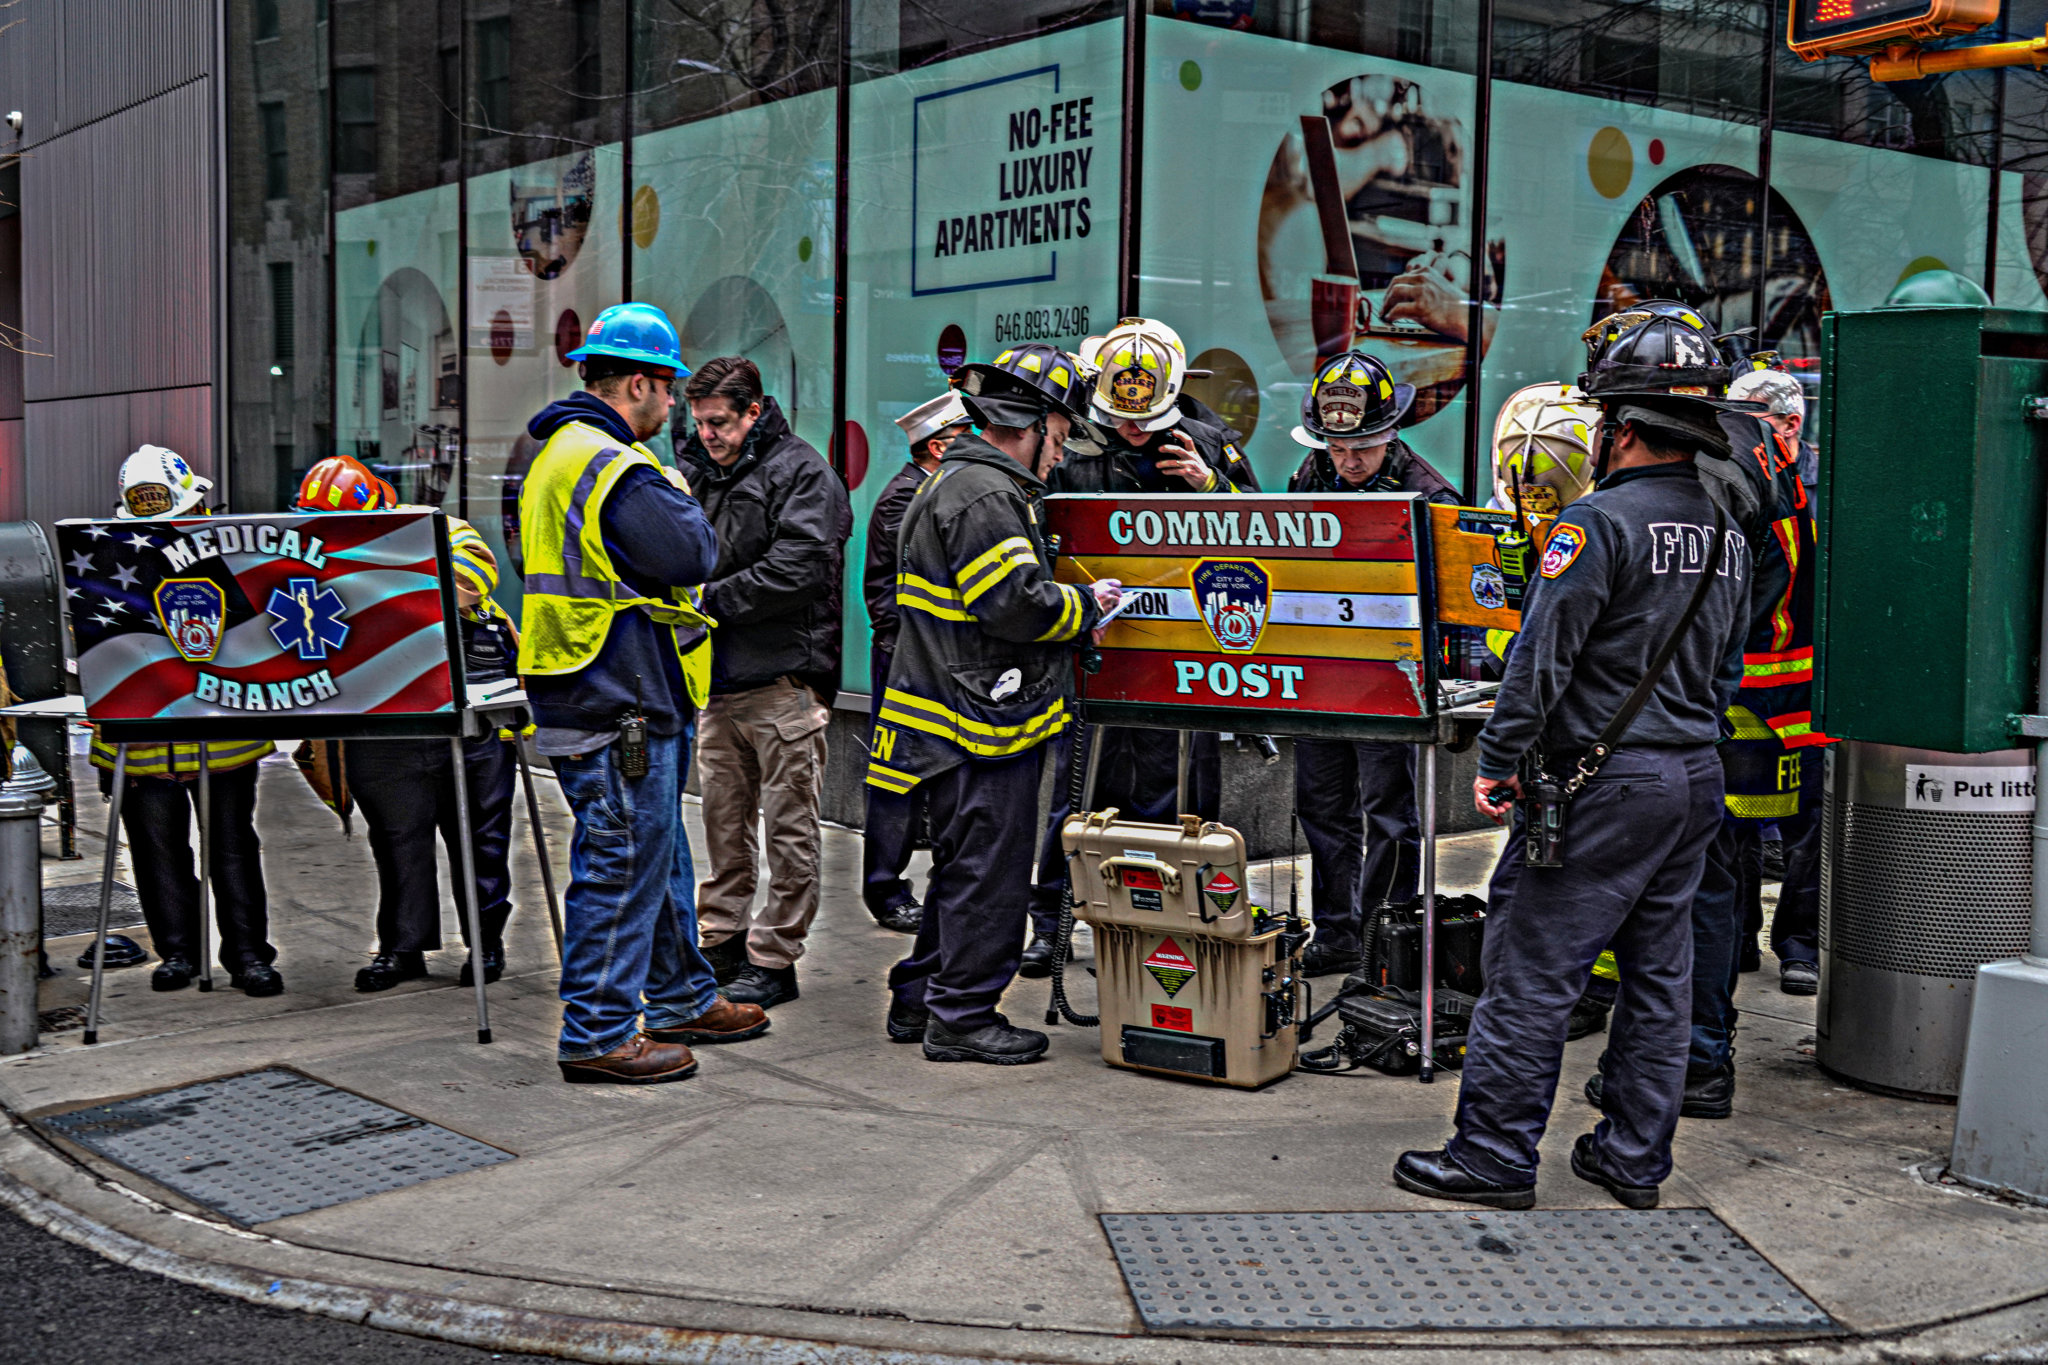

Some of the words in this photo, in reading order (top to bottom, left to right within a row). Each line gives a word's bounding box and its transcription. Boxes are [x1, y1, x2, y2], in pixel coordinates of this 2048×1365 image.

[1009, 96, 1094, 152] NO-FEE
[1000, 146, 1094, 201] LUXURY
[934, 197, 1091, 258] APARTMENTS
[995, 306, 1089, 342] 646.893.2496
[1336, 411, 1344, 423] 1
[1109, 510, 1342, 548] COMMAND
[161, 525, 327, 573] MEDICAL
[1198, 569, 1213, 584] FIRE
[1213, 563, 1264, 585] DEPARTMENT
[1338, 598, 1355, 622] 3
[195, 669, 340, 711] BRANCH
[1174, 660, 1304, 699] POST
[1954, 781, 1993, 797] Put
[1155, 952, 1185, 962] WARNING
